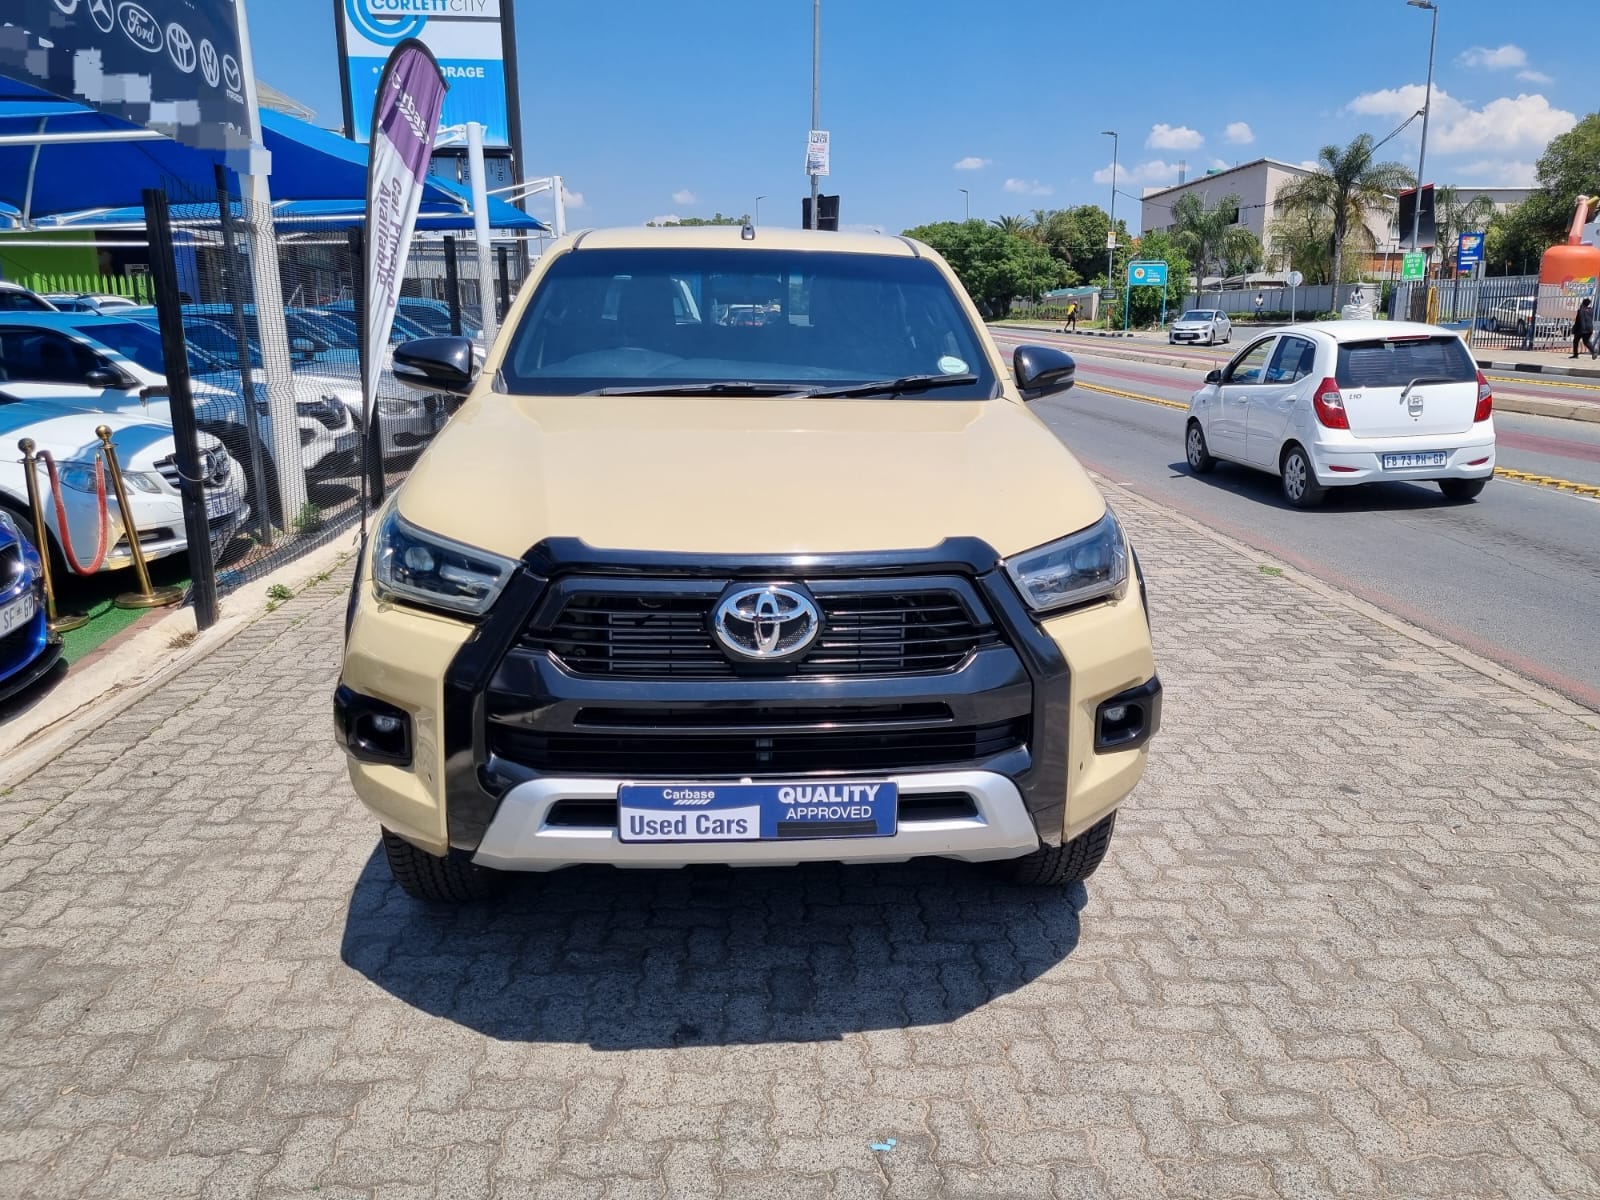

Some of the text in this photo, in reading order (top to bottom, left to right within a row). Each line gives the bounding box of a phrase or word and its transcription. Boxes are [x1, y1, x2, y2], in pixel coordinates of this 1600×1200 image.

[127, 9, 155, 44] Ford
[440, 67, 485, 78] ORAGE
[391, 177, 402, 217] Car
[377, 181, 392, 286] Available
[1386, 453, 1444, 466] FB 73 PH GP
[4, 607, 14, 630] SF
[663, 789, 715, 800] Carbase
[778, 784, 881, 804] QUALITY
[786, 806, 872, 821] APPROVED
[630, 814, 748, 836] Used Cars
